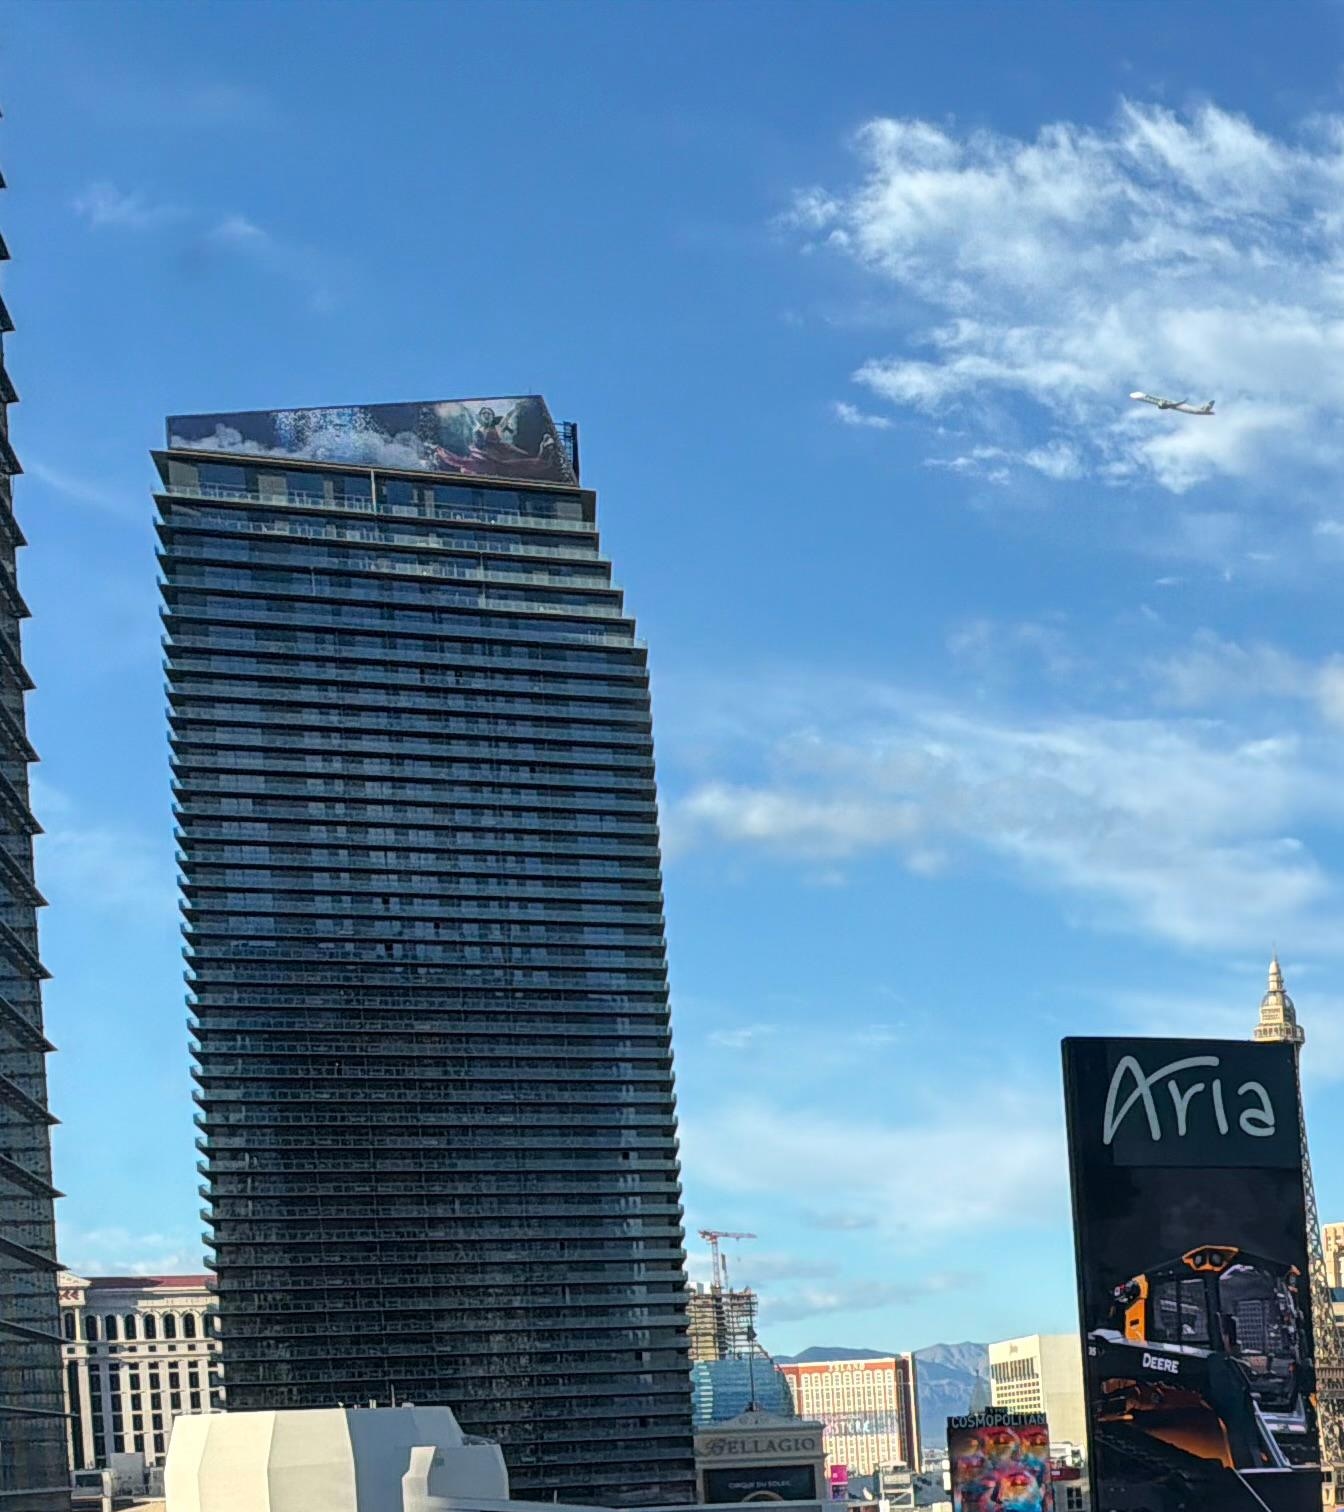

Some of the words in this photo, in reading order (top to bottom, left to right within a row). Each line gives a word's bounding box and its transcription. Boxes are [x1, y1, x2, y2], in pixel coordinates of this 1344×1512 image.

[1103, 1055, 1276, 1145] Aria
[1142, 1352, 1180, 1374] DEERE
[951, 1412, 1045, 1429] COSMOPOLITAN
